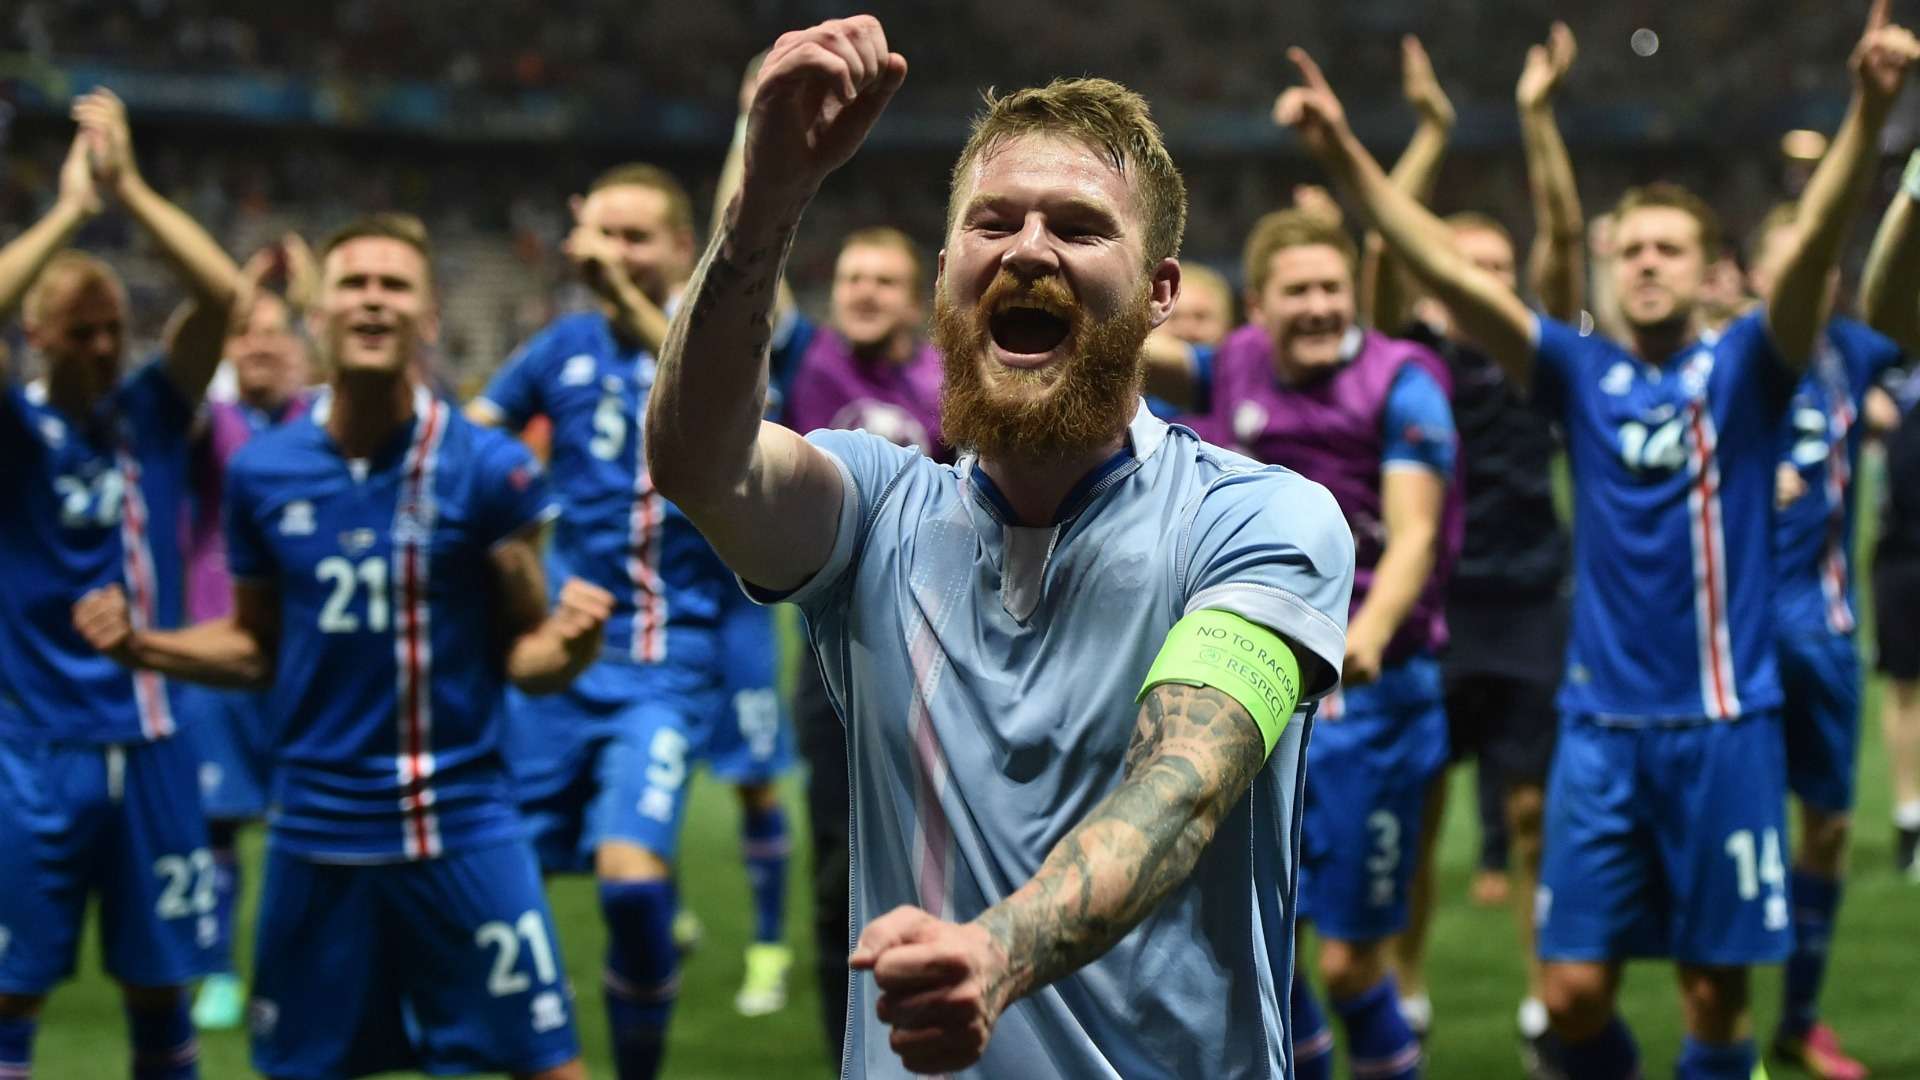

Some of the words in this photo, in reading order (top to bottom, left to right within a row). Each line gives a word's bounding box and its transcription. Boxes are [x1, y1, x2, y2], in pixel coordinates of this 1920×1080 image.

[1617, 421, 1684, 467] 14
[316, 556, 388, 632] 21
[1196, 626, 1226, 640] NO
[1232, 633, 1255, 652] TO
[1257, 649, 1297, 702] RACISM
[1226, 658, 1285, 719] RESPECT
[1367, 811, 1400, 872] 3
[1725, 826, 1786, 899] 14
[474, 910, 558, 998] 21
